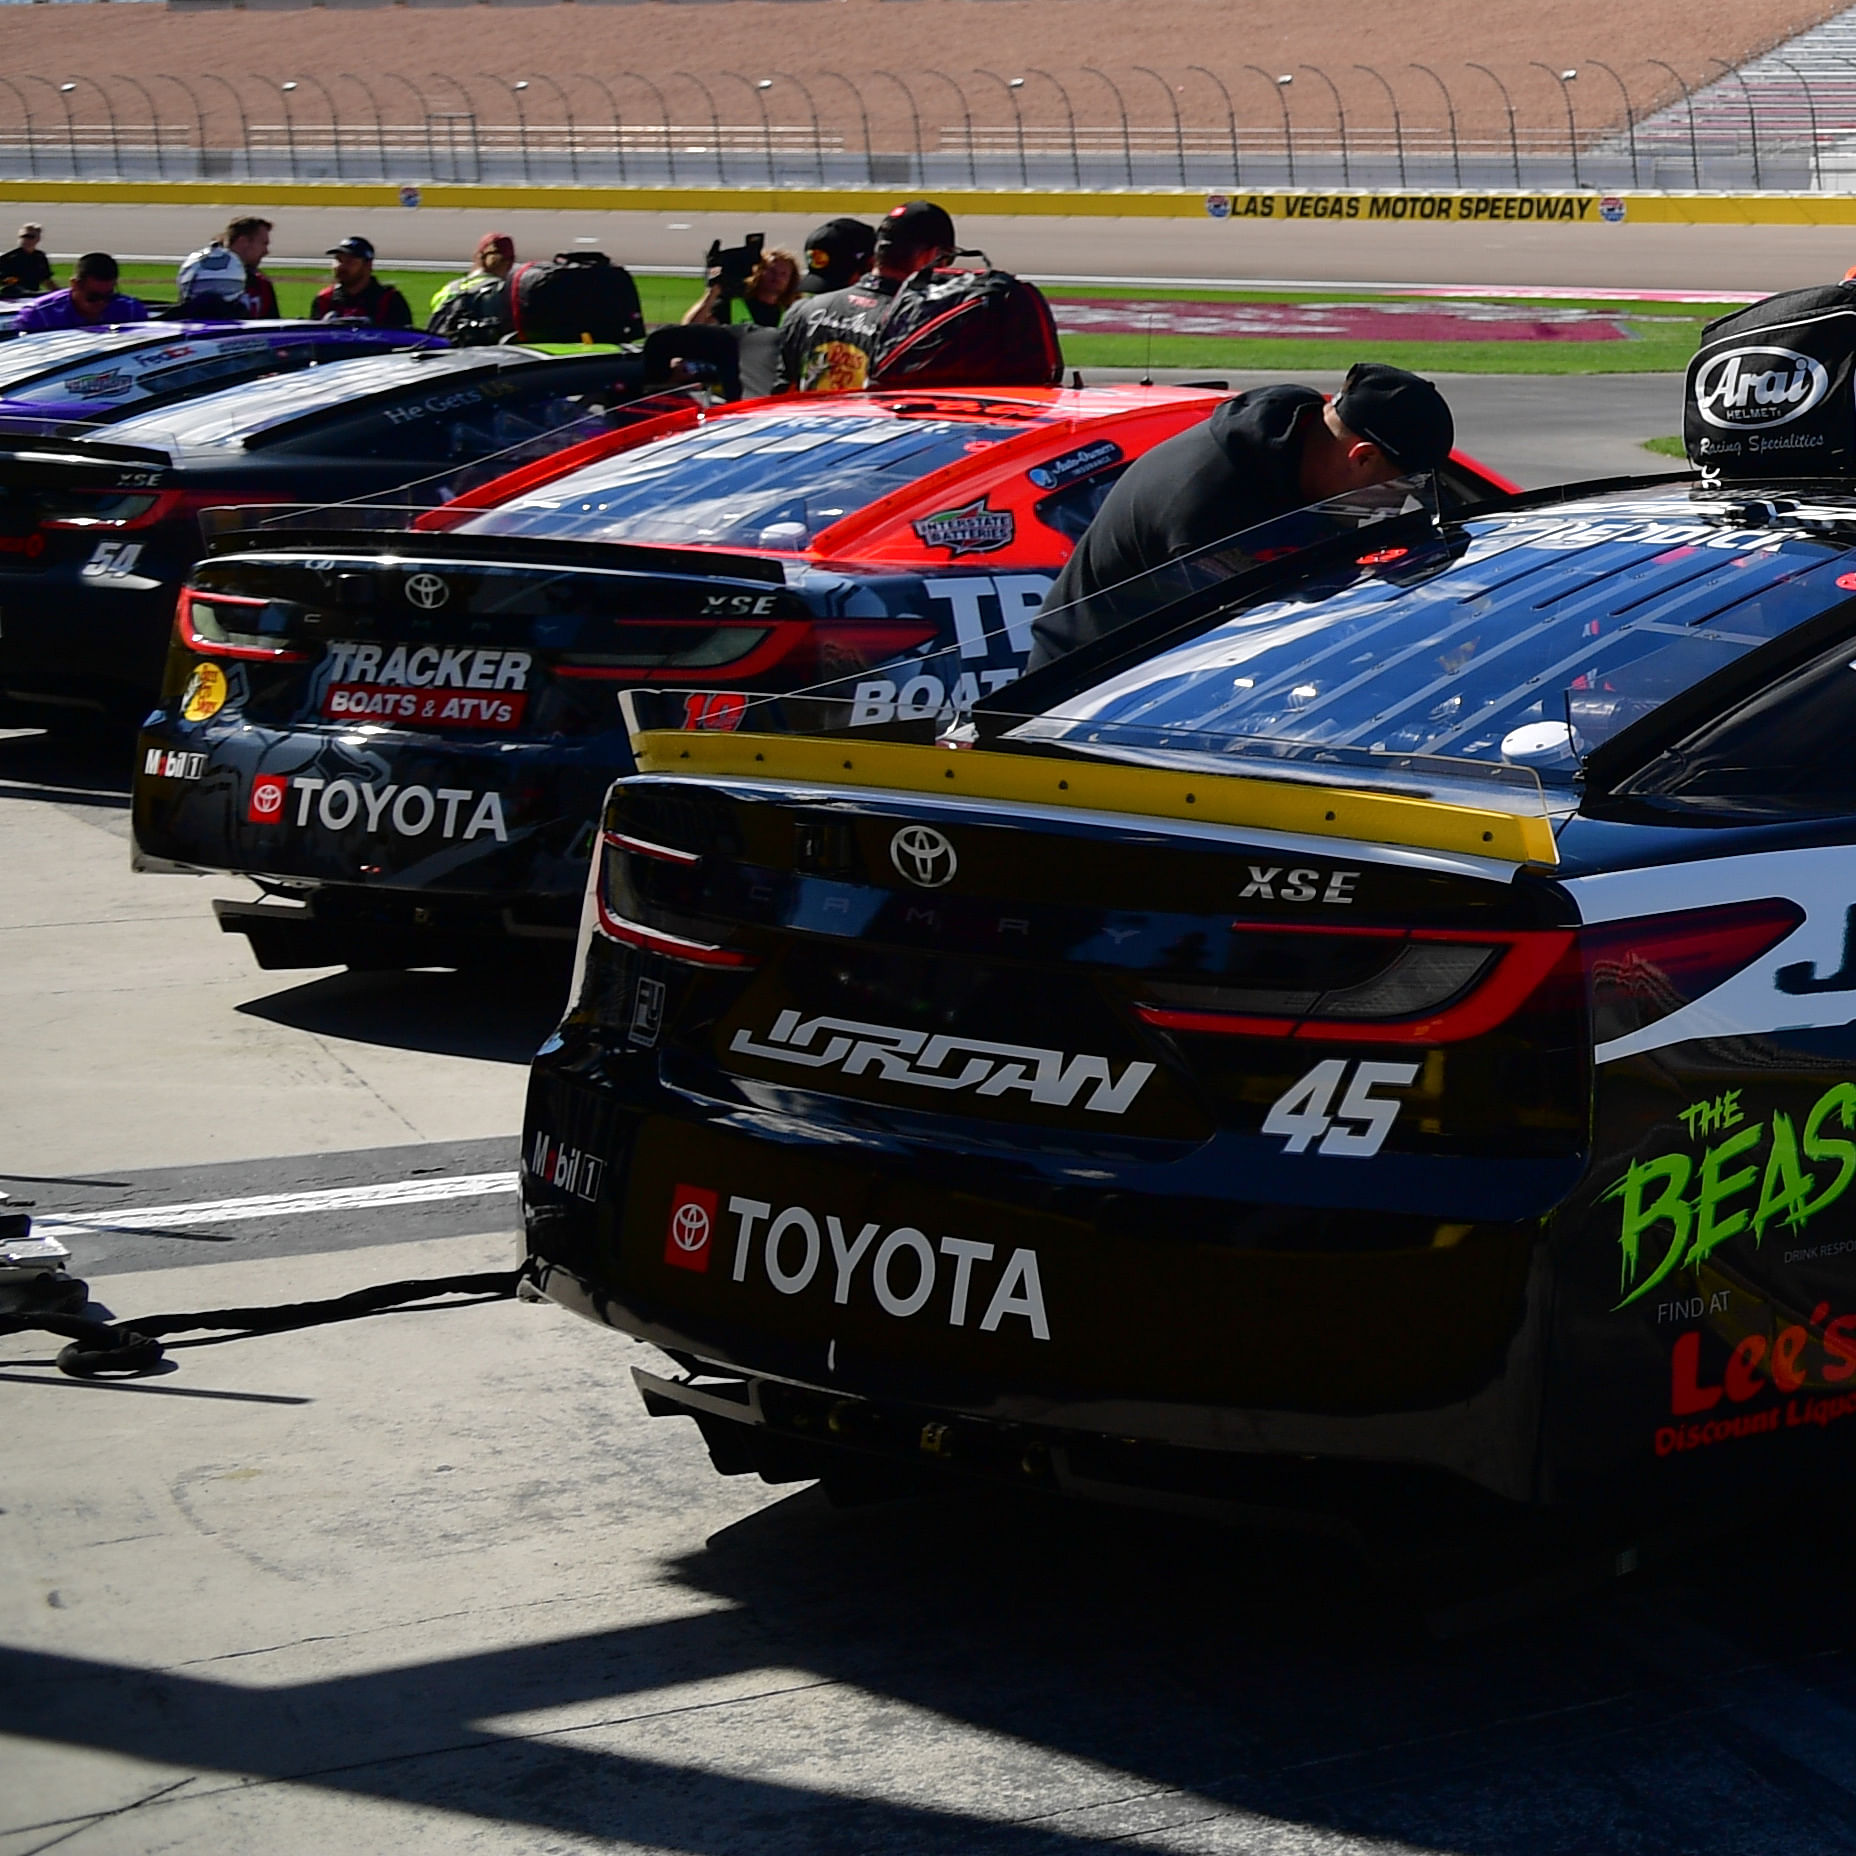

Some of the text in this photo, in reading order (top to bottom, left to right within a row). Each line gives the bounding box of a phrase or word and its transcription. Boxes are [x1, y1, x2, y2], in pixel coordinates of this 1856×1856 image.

[1231, 196, 1592, 220] LAS VEGAS MOTOR SPEEDWAY
[134, 347, 195, 367] FedEx
[1702, 357, 1810, 408] Arai
[384, 401, 423, 425] He
[425, 390, 483, 417] Gets
[1700, 433, 1824, 456] Racing Specialities
[117, 473, 163, 488] XSE
[915, 517, 1011, 537] INTERSTATE
[82, 542, 146, 578] 54
[701, 596, 777, 615] XSE
[330, 644, 533, 691] TRACKER
[330, 691, 513, 723] BOATS & ATVs
[144, 749, 186, 779] Mobil
[293, 778, 508, 841] TOYOTA
[1238, 865, 1362, 904] XSE
[730, 1009, 1157, 1114] JORDAN
[1261, 1058, 1421, 1158] 45
[1676, 1088, 1746, 1142] THE
[532, 1131, 579, 1194] Mobil
[728, 1196, 1051, 1341] TOYOTA
[1784, 1244, 1819, 1265] DRINK
[1657, 1289, 1731, 1324] FIND AT
[1654, 1406, 1780, 1457] Discount
